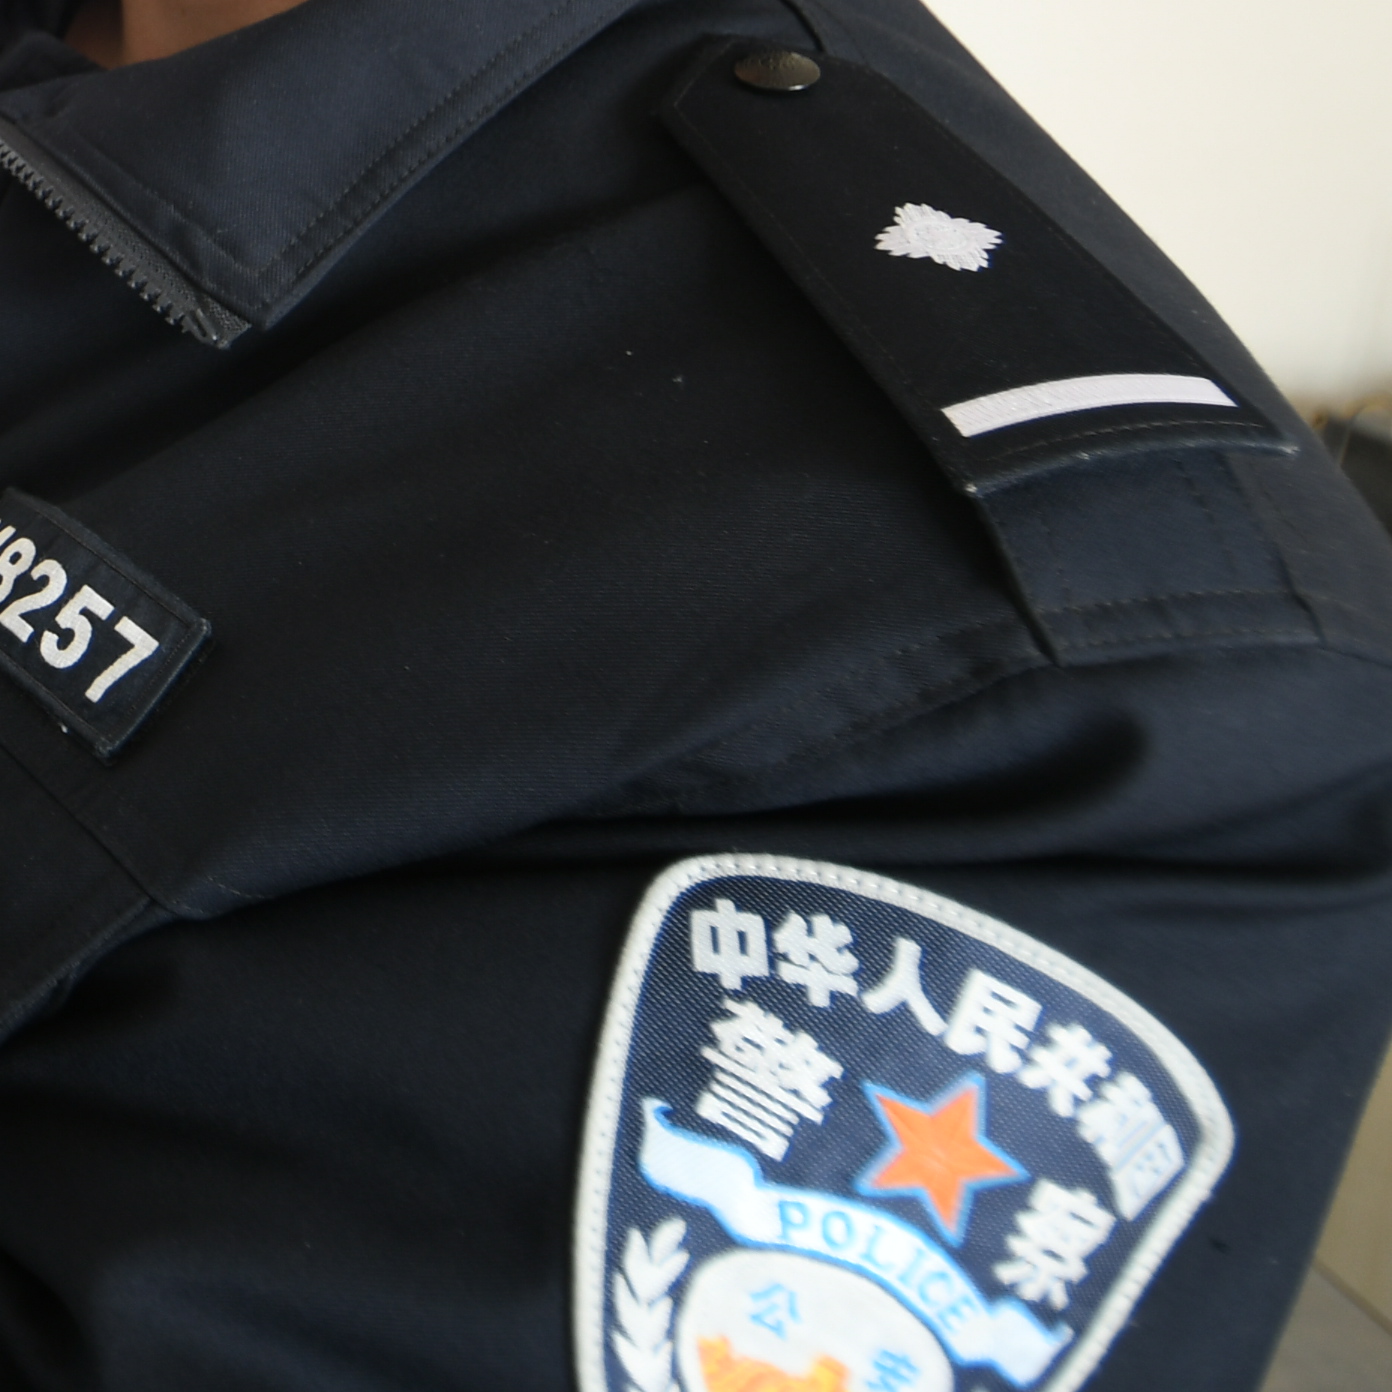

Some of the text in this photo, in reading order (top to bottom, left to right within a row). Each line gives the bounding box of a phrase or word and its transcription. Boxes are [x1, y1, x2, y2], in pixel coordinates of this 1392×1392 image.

[690, 897, 1186, 1223] 中华人民共和国
[777, 1199, 977, 1334] POLICE
